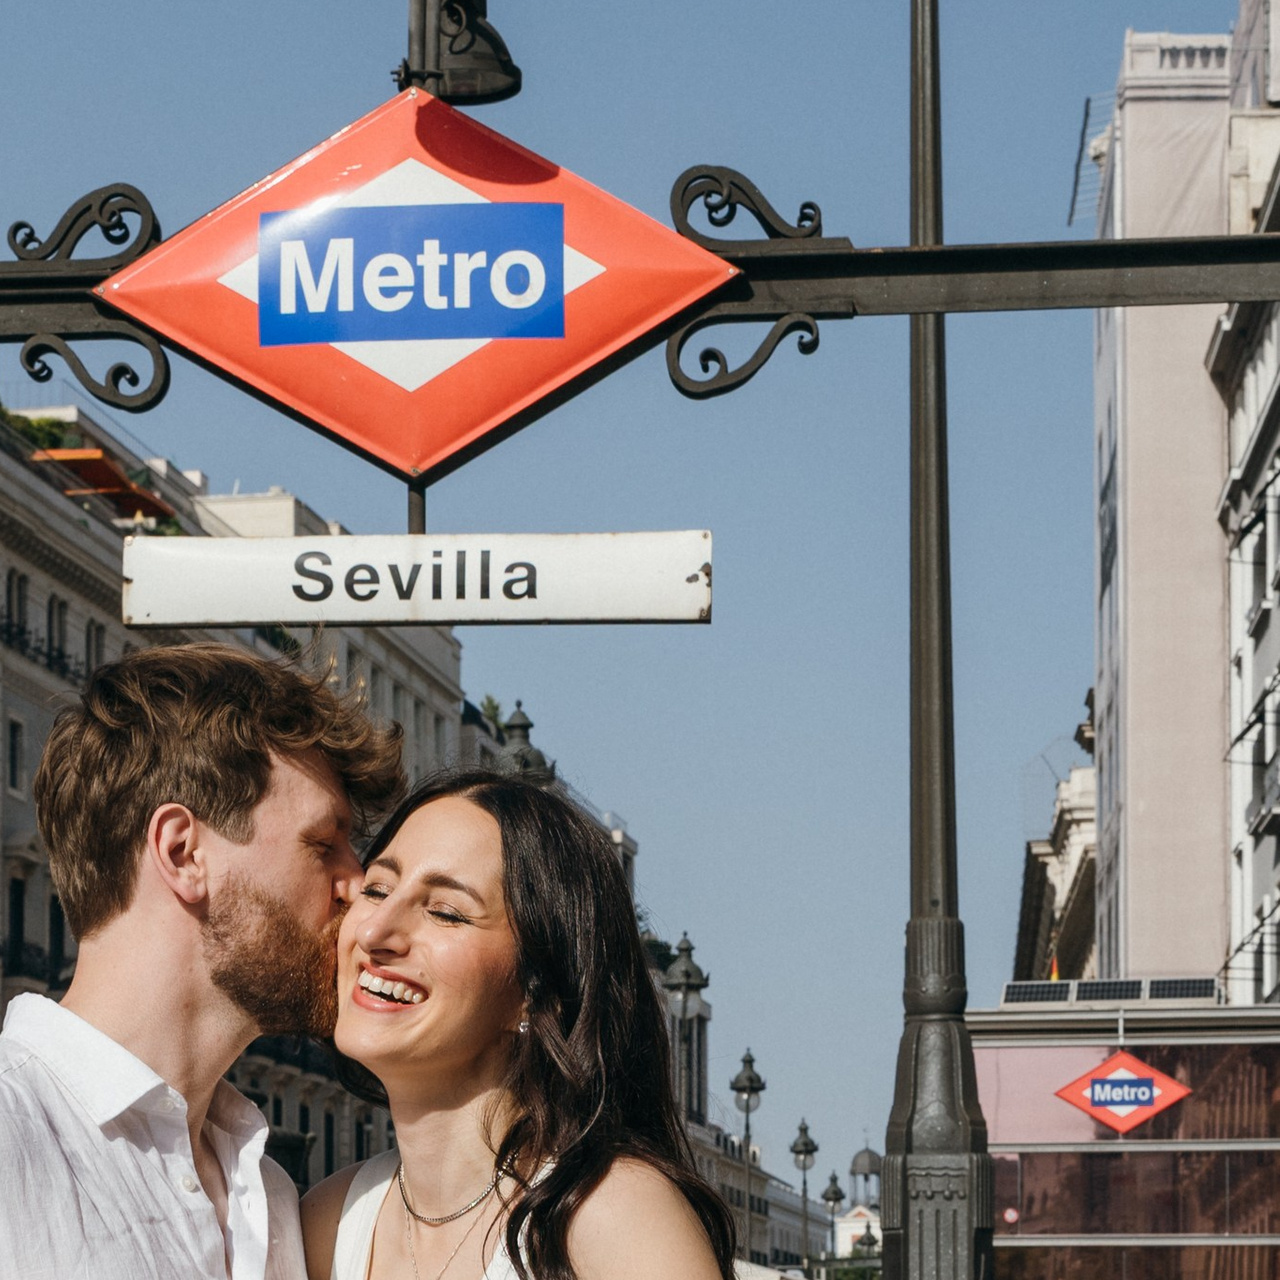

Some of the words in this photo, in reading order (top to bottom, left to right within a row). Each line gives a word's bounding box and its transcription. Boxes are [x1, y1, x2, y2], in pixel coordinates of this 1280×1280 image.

[279, 237, 547, 315] Metro
[291, 549, 538, 602] Sevilla
[1093, 1083, 1151, 1102] Metro
